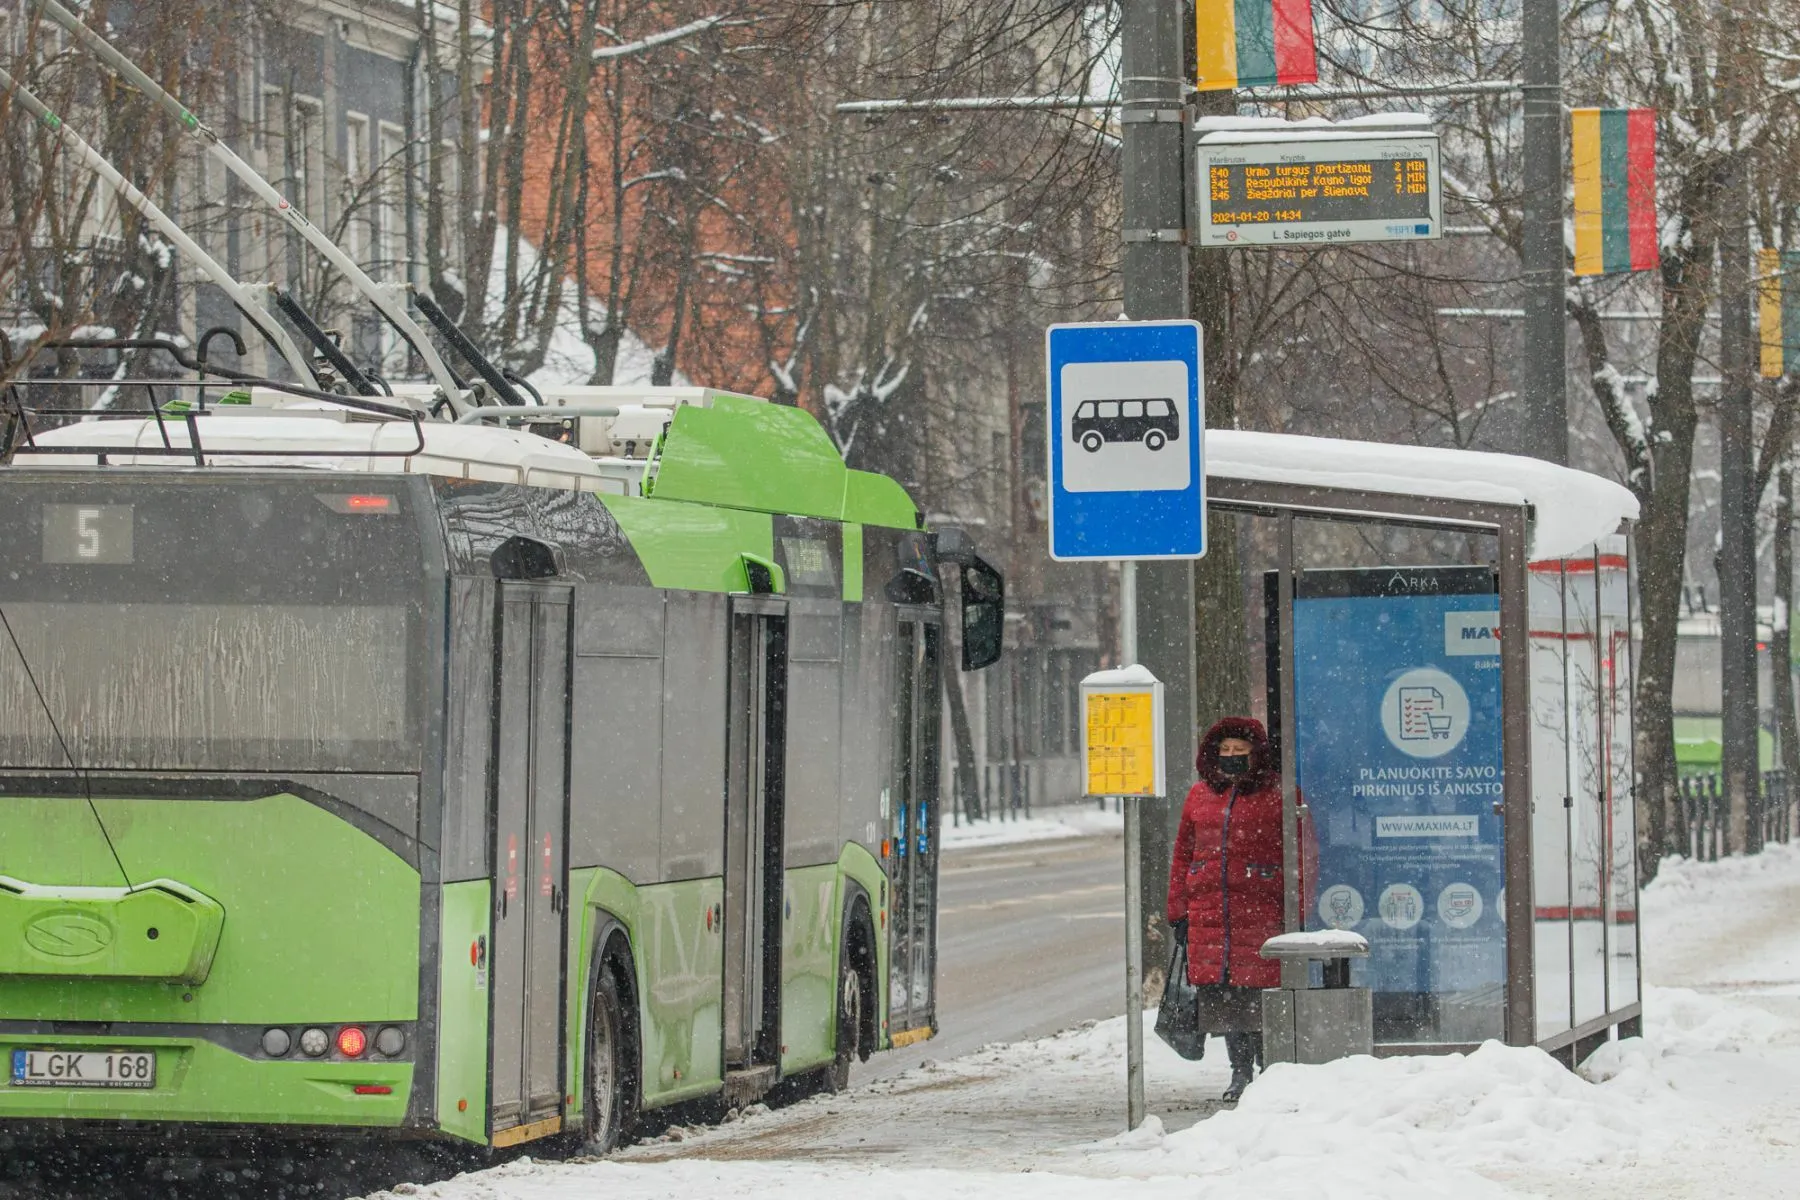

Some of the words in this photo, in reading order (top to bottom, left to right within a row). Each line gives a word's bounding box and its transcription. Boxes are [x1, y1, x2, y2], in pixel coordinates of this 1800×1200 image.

[1280, 154, 1305, 162] Kryptis
[1245, 167, 1271, 177] Urmo
[1275, 165, 1310, 177] turgus
[1394, 161, 1402, 171] 2
[1406, 160, 1425, 171] MIN
[1246, 175, 1308, 189] Respublikinė
[1313, 174, 1345, 186] Kauno
[1407, 172, 1426, 182] MIN
[1300, 189, 1318, 199] per
[1395, 184, 1402, 194] 7
[1407, 183, 1426, 193] MIN
[1212, 211, 1270, 223] 2021-01-20
[1274, 209, 1302, 221] 14:34
[1273, 230, 1281, 239] L.
[1283, 229, 1325, 241] Sapiegos
[1327, 227, 1351, 240] gatvė
[79, 509, 99, 557] 5
[1388, 571, 1439, 588] ARKA
[1360, 766, 1452, 780] PLANUOKITE
[1456, 766, 1496, 779] SAVO
[1353, 783, 1425, 797] PIRKINIUS
[1428, 780, 1440, 796] IŠ
[1443, 782, 1504, 796] ANKSTO
[1381, 821, 1474, 832] WWW.MAXIMA.LT
[14, 1067, 25, 1076] LT
[29, 1053, 83, 1078] LGK
[105, 1055, 149, 1079] 168
